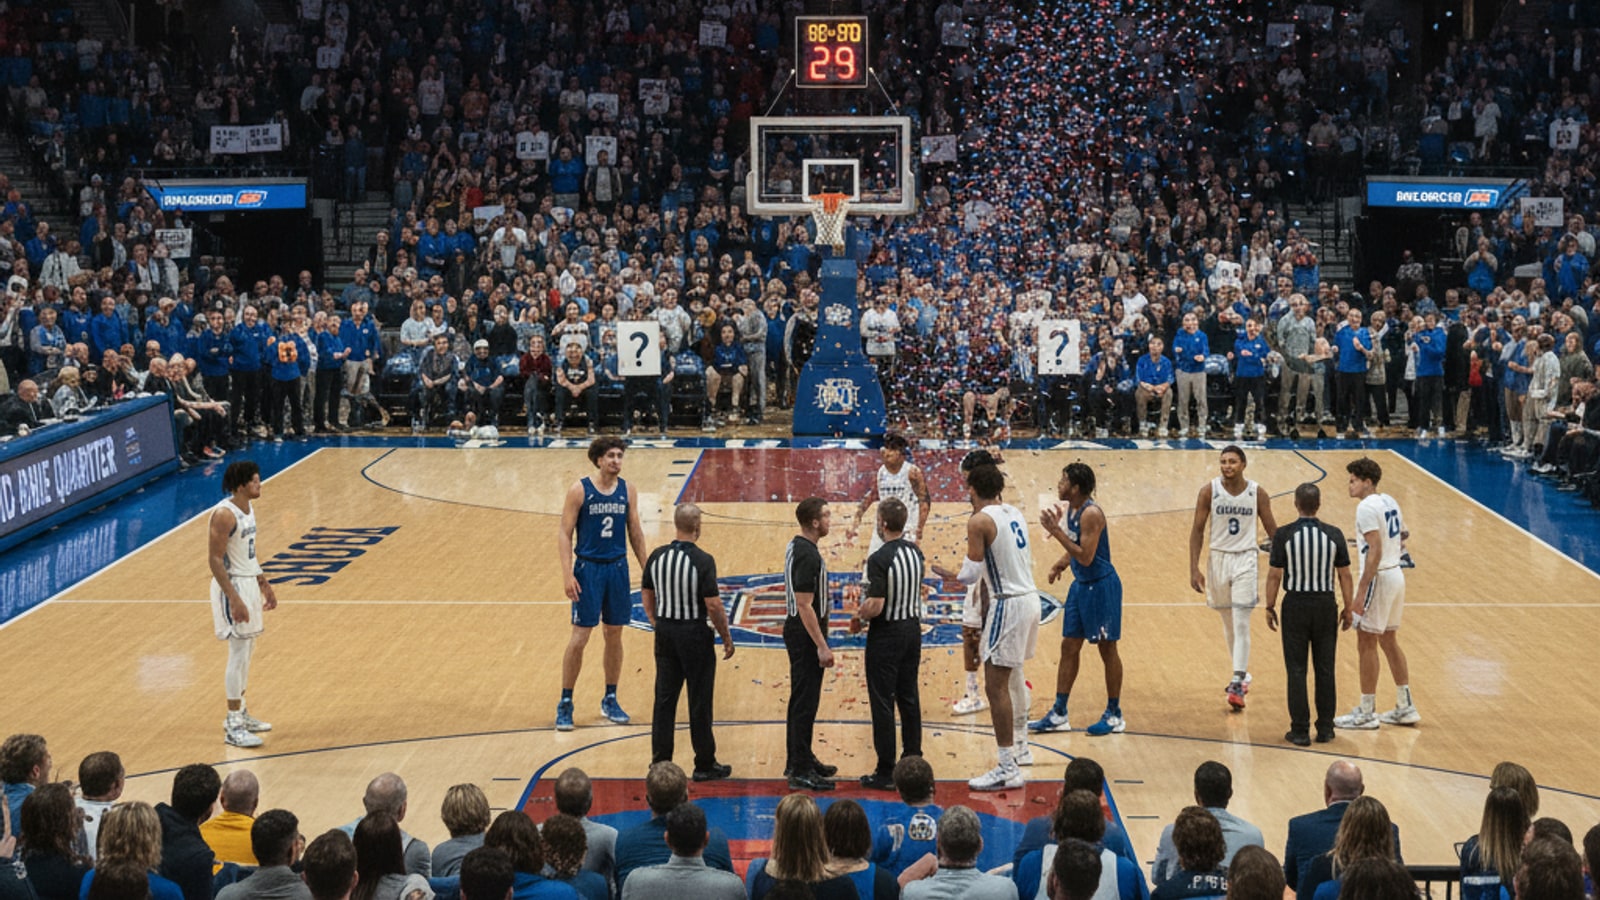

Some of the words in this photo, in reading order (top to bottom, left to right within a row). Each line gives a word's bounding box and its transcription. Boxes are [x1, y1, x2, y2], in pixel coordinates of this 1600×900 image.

[810, 45, 855, 80] 29
[629, 331, 649, 367] ?
[1049, 329, 1069, 366] ?
[601, 516, 614, 538] 2
